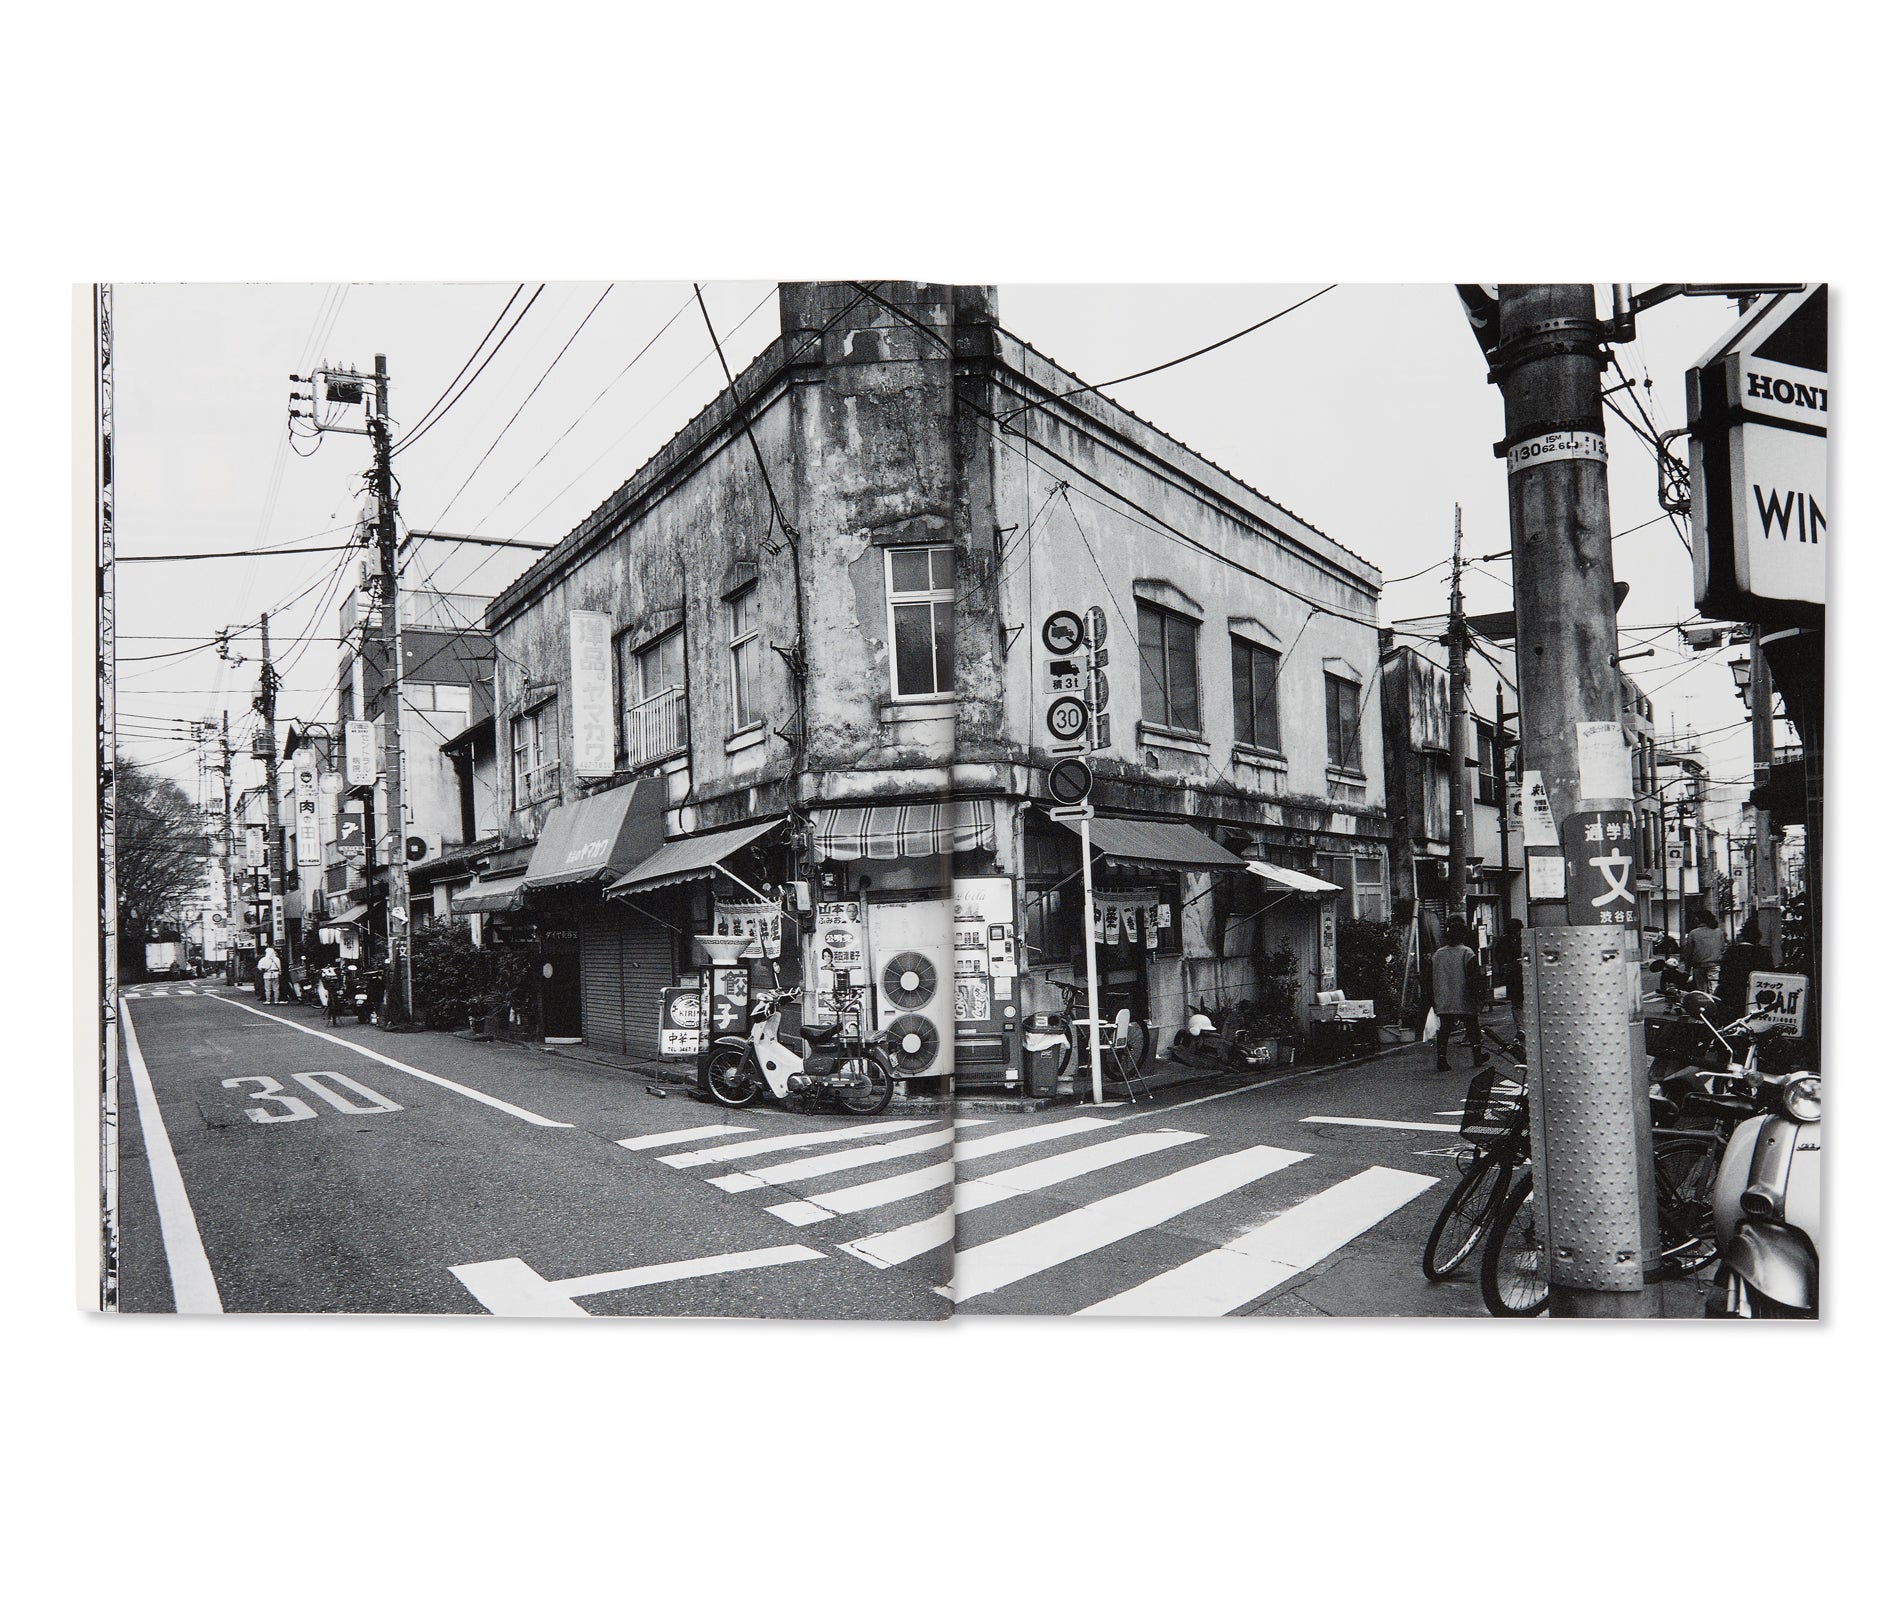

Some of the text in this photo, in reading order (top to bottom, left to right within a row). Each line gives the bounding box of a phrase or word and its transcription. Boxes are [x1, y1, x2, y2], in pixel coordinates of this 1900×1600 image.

[1056, 708, 1080, 729] 30
[1589, 847, 1636, 907] 文
[818, 903, 845, 915] 山本
[818, 916, 842, 925] ふみお
[1600, 910, 1634, 923] 渋谷区
[825, 934, 853, 943] 公明党
[1756, 981, 1784, 990] スナック
[713, 970, 748, 1030] 餃子
[221, 1071, 405, 1124] 30
